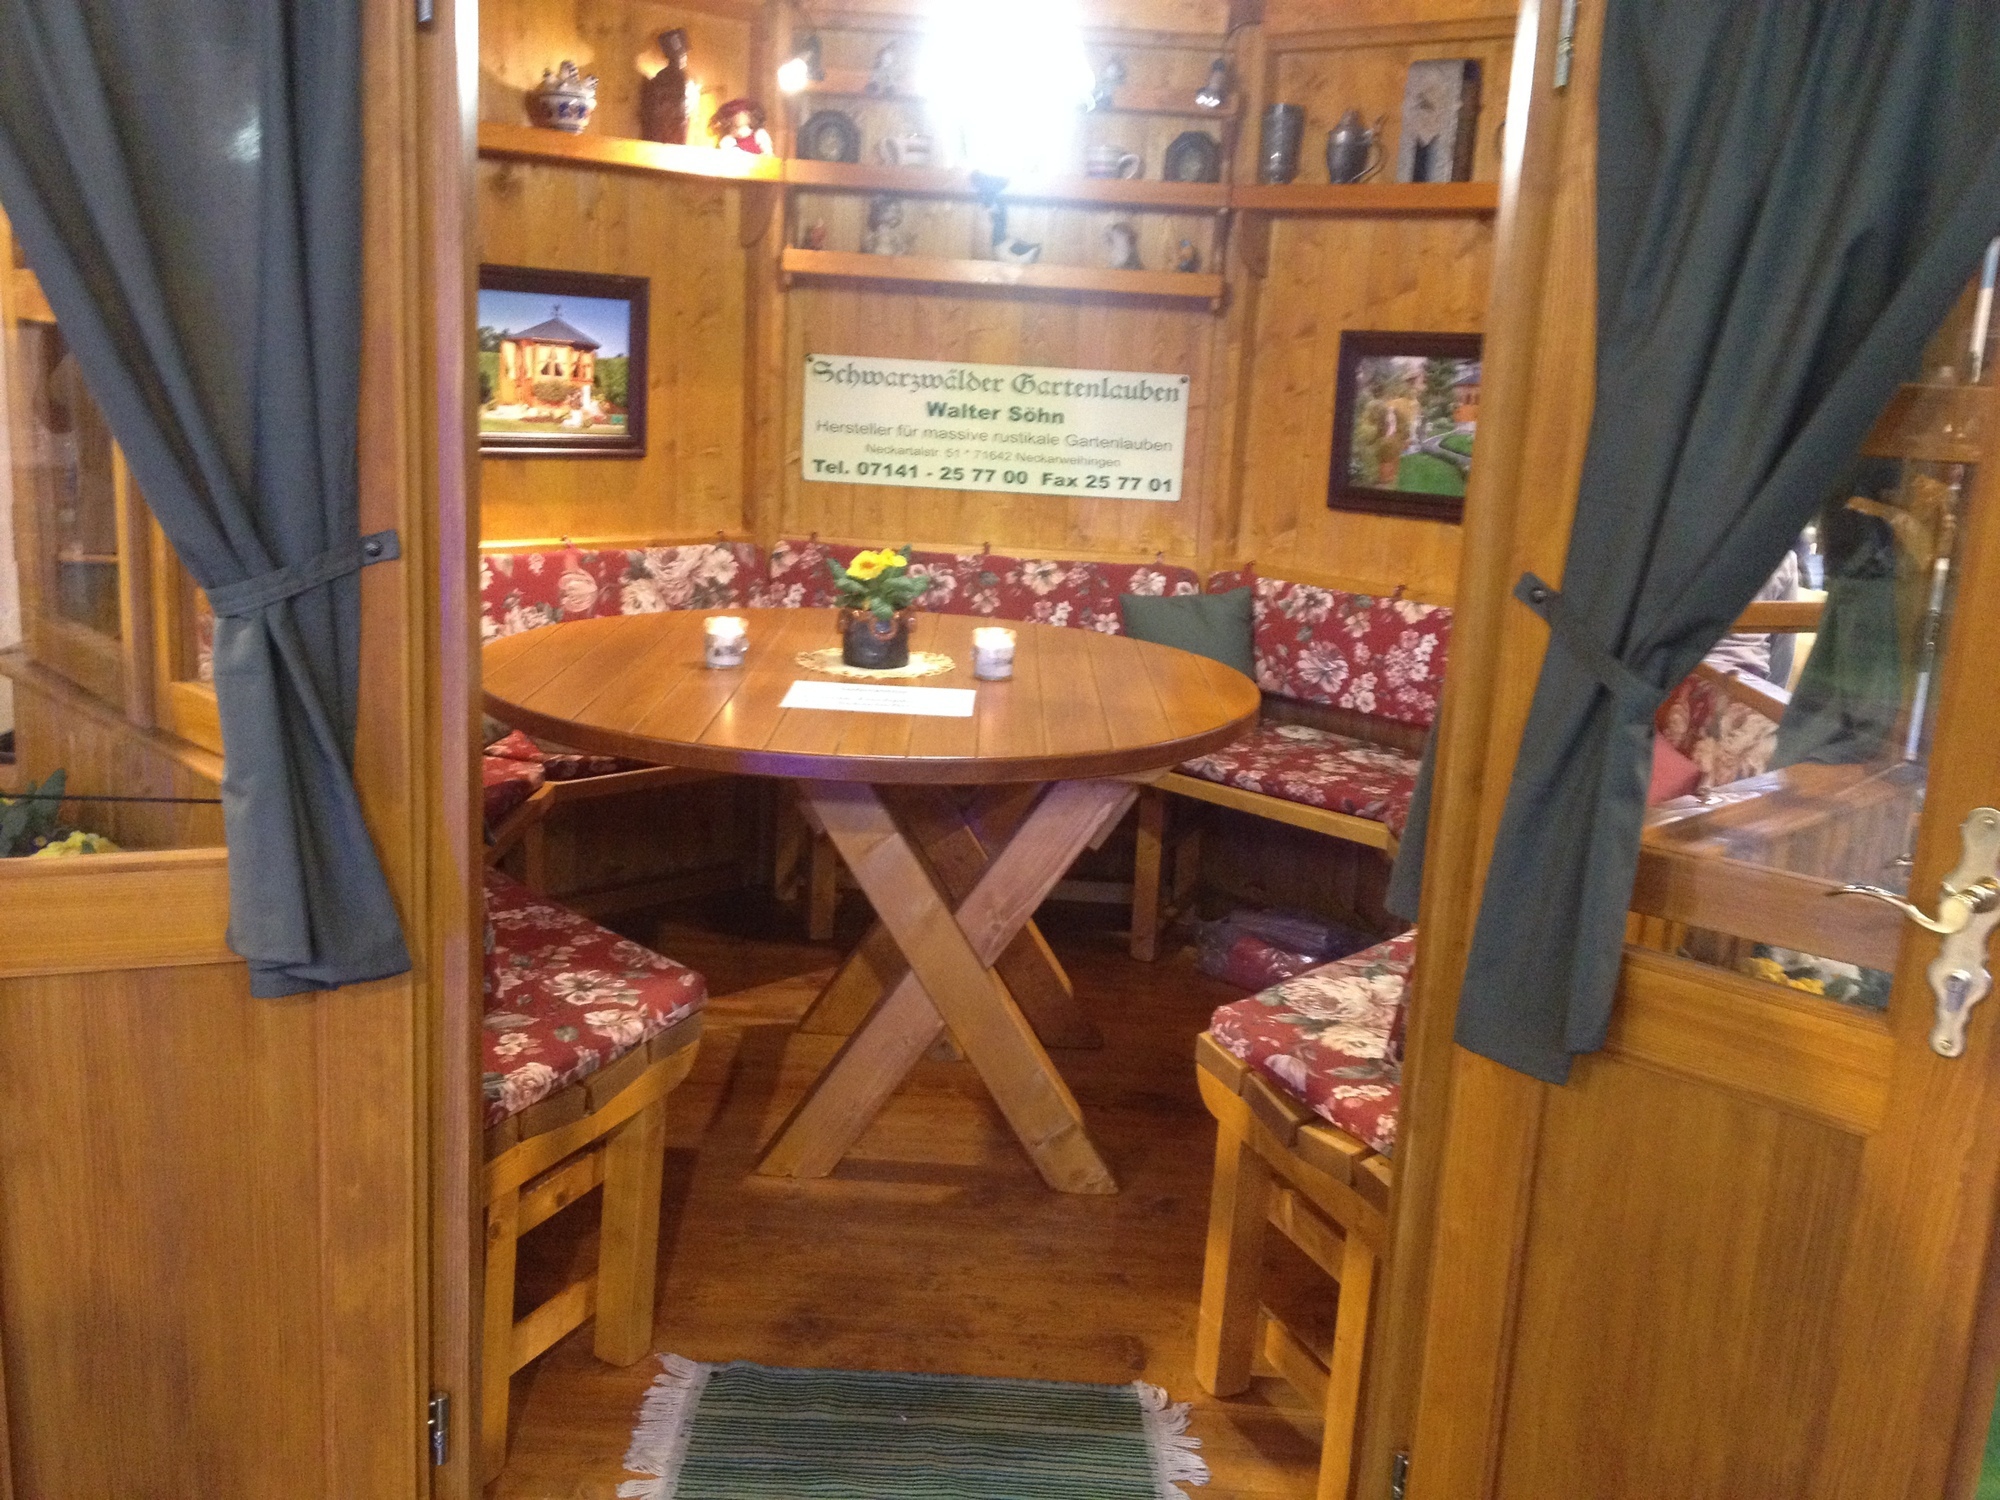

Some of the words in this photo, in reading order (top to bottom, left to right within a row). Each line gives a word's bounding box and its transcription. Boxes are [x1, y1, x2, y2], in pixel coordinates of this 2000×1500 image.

[812, 360, 1005, 393] Schwarzwälder
[1011, 373, 1181, 402] Gartenlauben
[927, 401, 1001, 420] Walter
[1008, 405, 1066, 424] Söhn
[816, 419, 893, 437] Hersteller
[897, 424, 919, 437] für
[922, 428, 989, 442] massive
[993, 432, 1060, 447] rustikale
[1065, 433, 1173, 452] Gartenlauben
[974, 449, 1012, 461] 71642
[812, 458, 850, 475] Tel.
[856, 461, 918, 479] 07141
[939, 466, 965, 482] 25
[972, 468, 997, 484] 77
[1003, 470, 1029, 485] 00
[1041, 472, 1079, 488] Fax
[1084, 474, 1111, 490] 25
[1118, 476, 1143, 491] 77
[1149, 477, 1173, 493] 01
